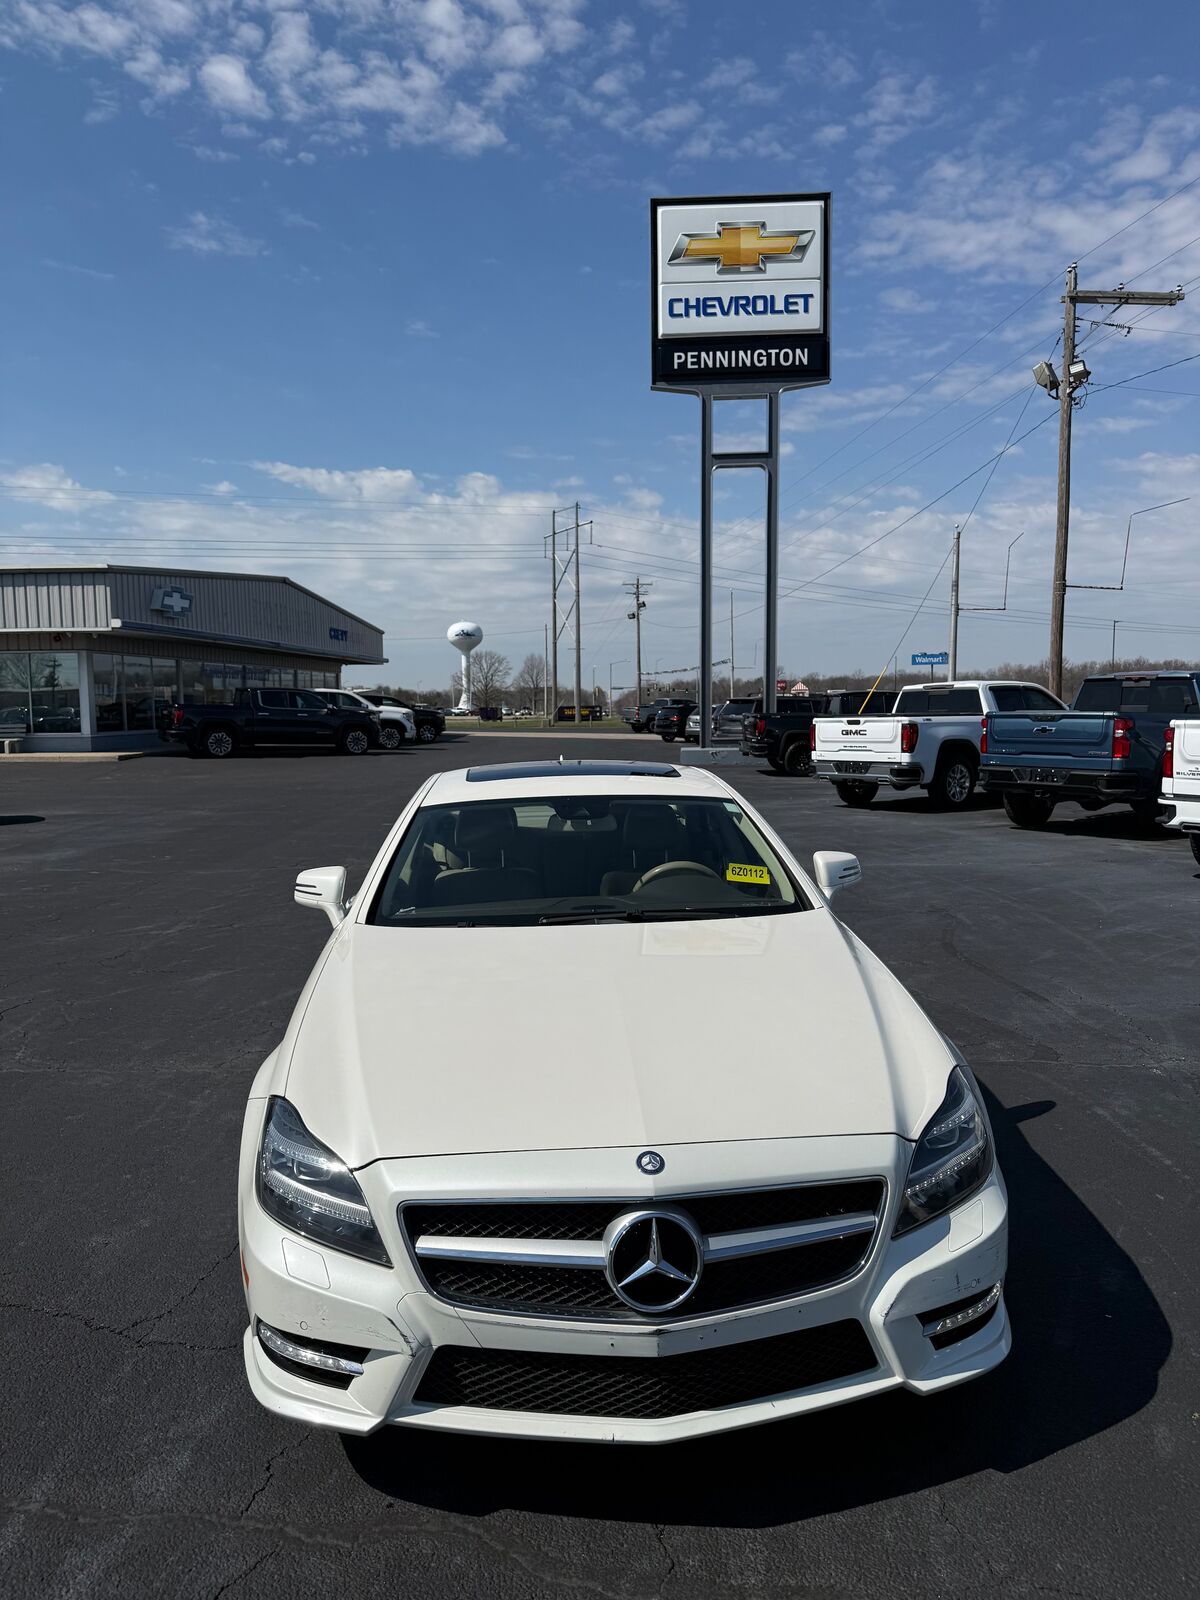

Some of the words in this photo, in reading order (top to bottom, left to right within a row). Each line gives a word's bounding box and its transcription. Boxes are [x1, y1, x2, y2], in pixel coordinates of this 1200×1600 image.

[668, 293, 814, 318] CHEVROLET
[673, 348, 809, 369] PENNINGTON
[731, 866, 764, 879] 6Z0112
